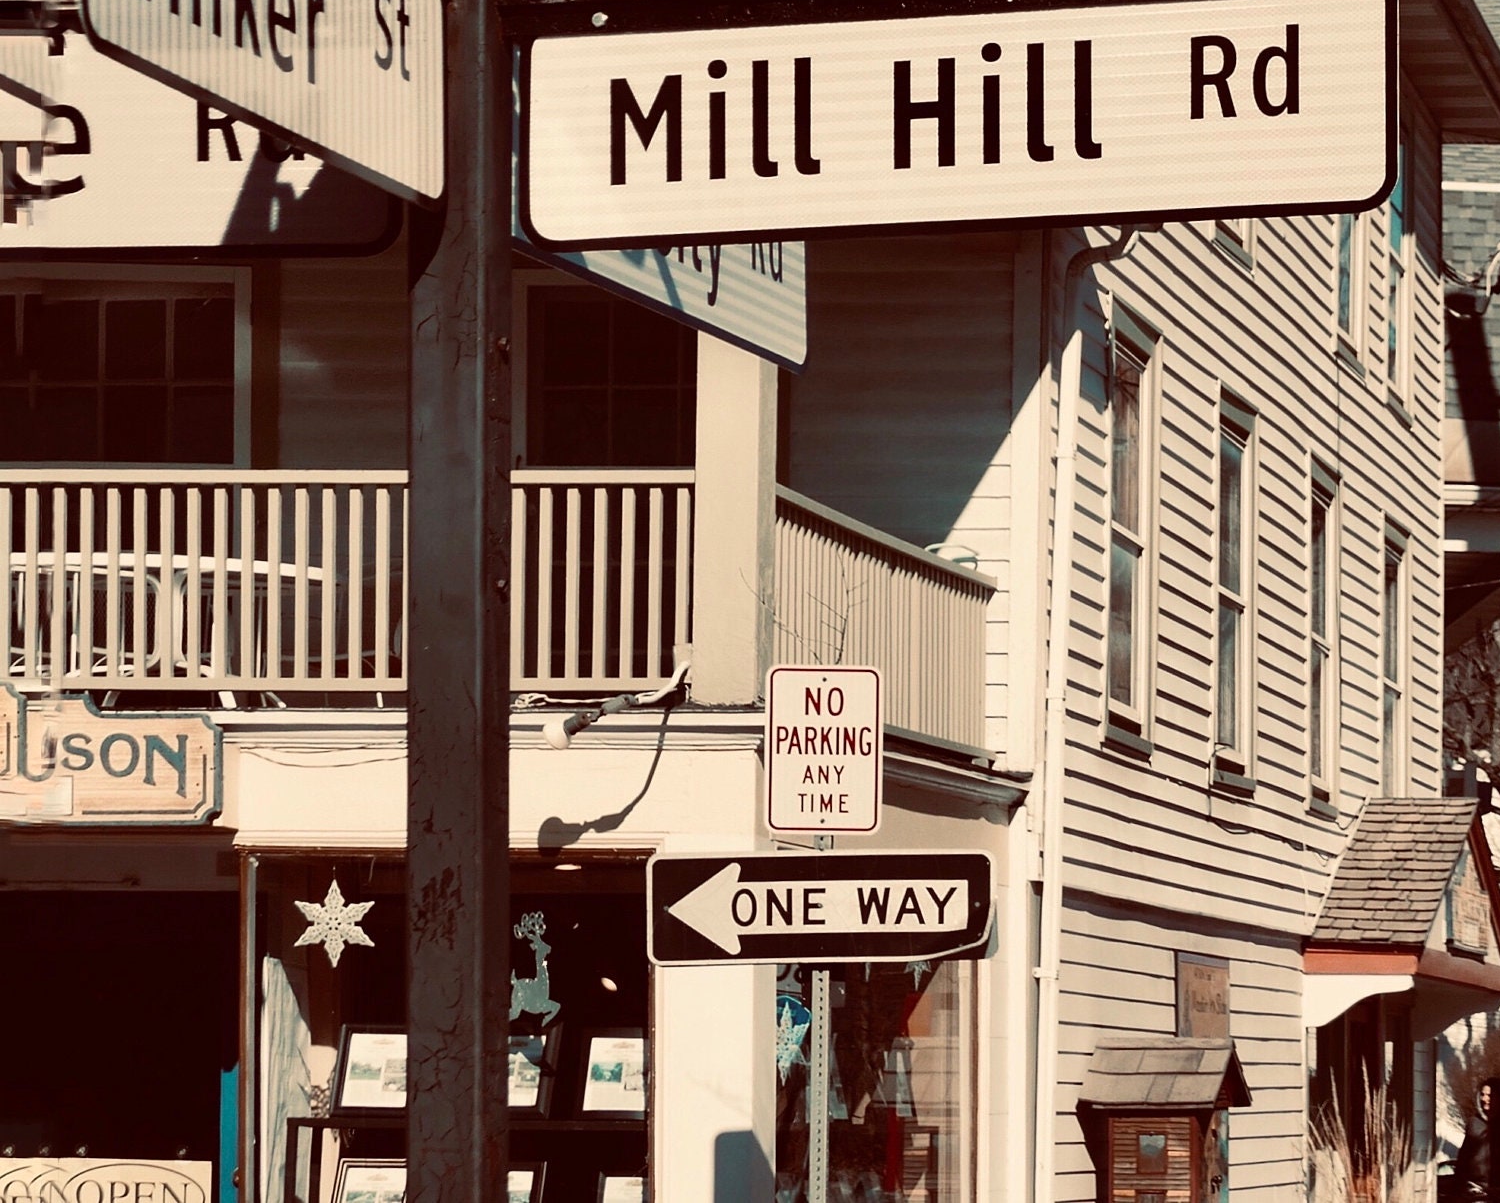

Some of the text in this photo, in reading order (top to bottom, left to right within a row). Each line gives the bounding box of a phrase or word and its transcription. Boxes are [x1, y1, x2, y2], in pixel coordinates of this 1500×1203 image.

[609, 24, 1300, 186] Mill Hill Rd
[804, 687, 844, 716] NO
[776, 726, 872, 756] PARKING
[802, 765, 845, 785] ANY
[798, 793, 849, 814] TIME
[731, 887, 958, 927] ONE WAY
